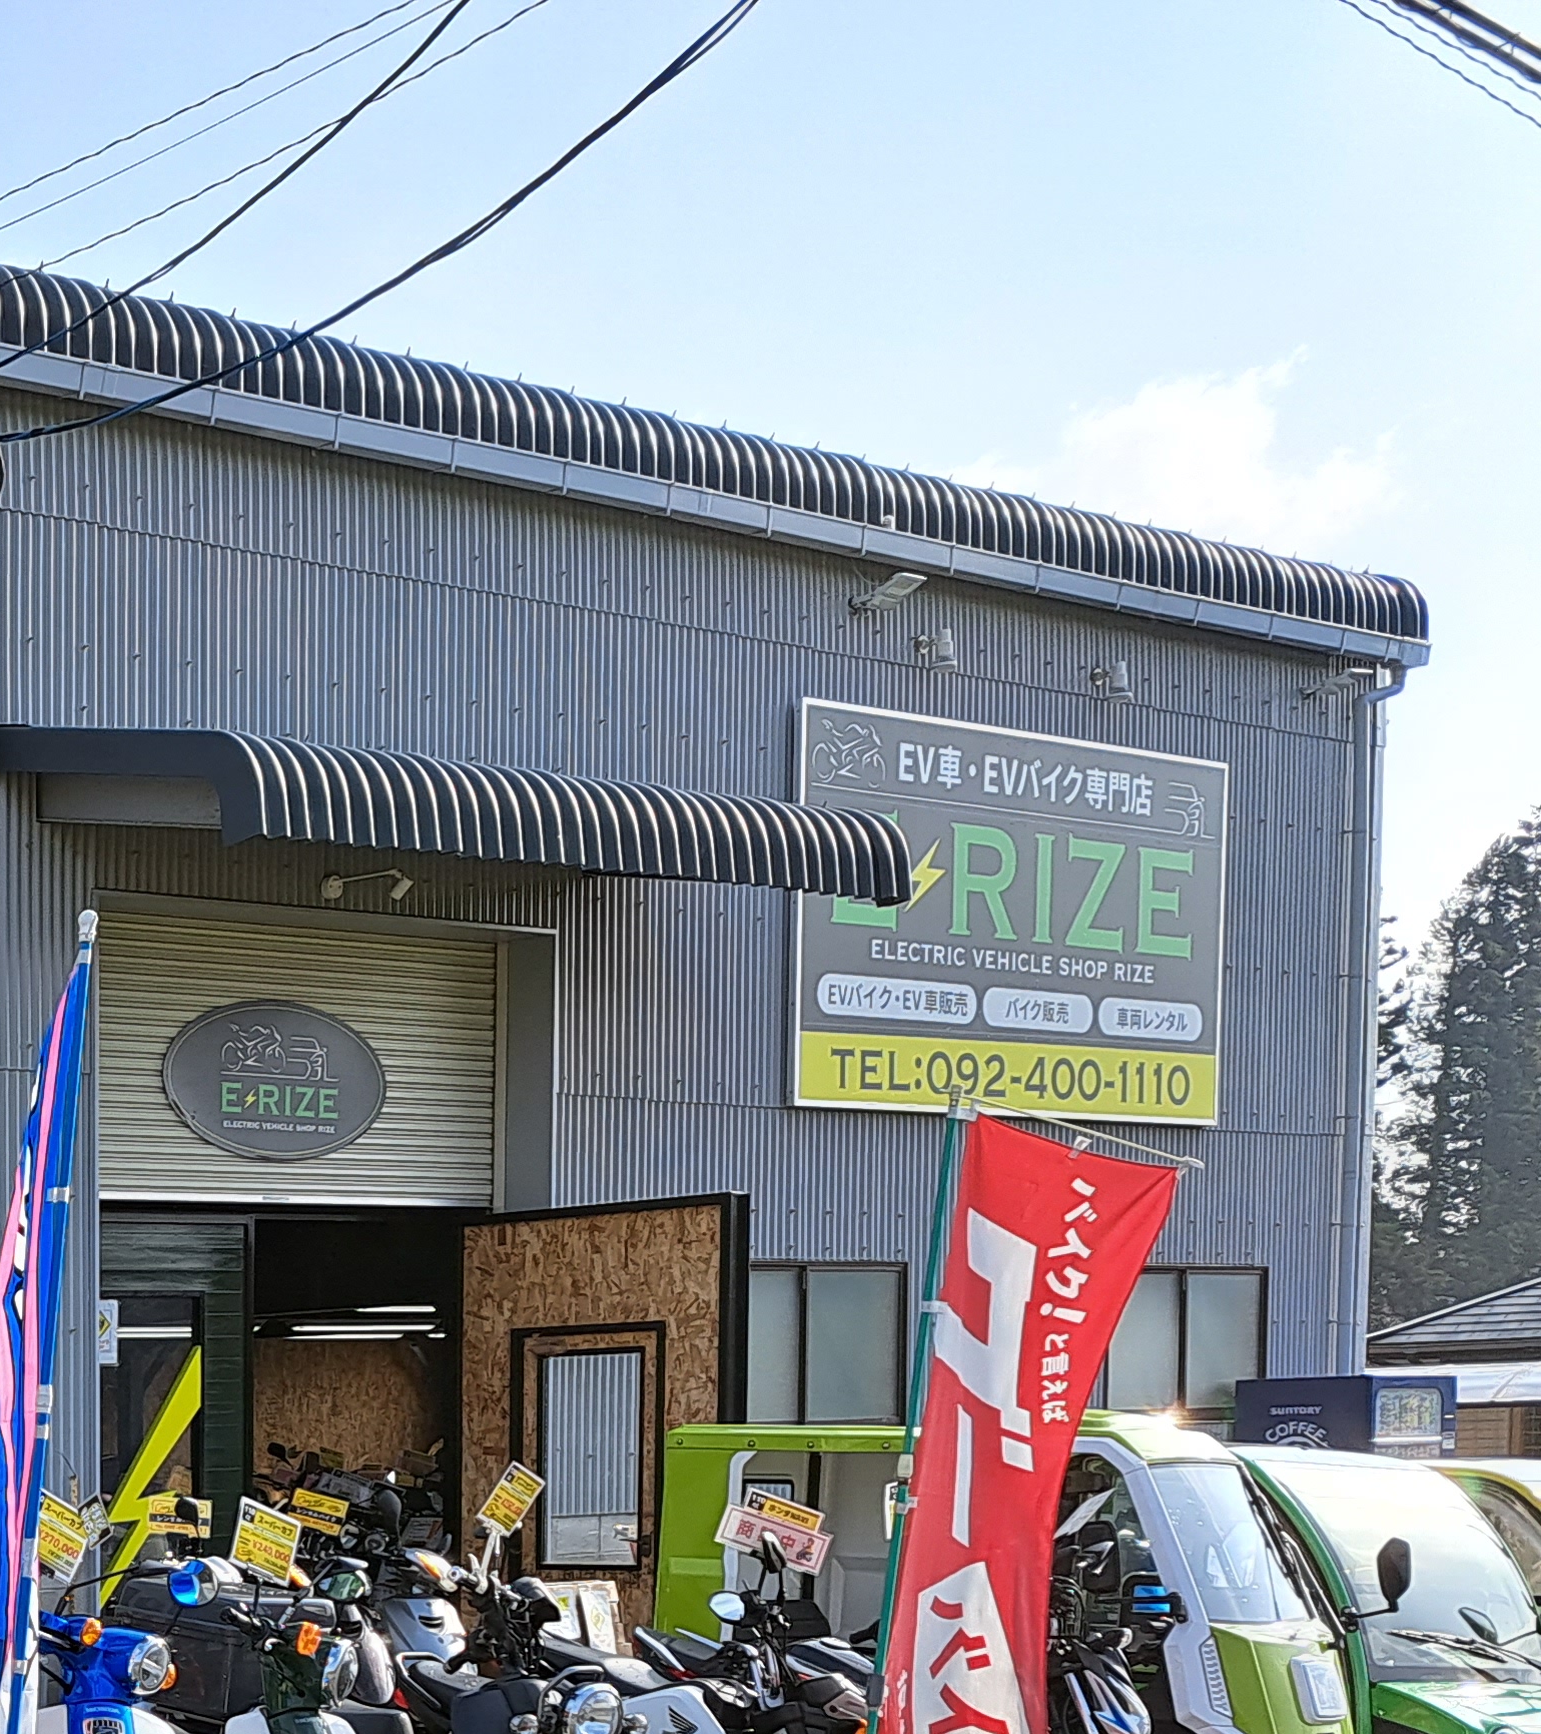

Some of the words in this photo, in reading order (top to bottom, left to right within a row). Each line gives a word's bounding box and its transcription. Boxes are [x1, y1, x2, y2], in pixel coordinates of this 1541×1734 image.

[898, 744, 1153, 817] EV車・EVバイク専門店
[871, 940, 966, 967] ELECTRIC
[972, 948, 1053, 975] VEHICLE
[1059, 958, 1108, 980] SHOP
[1114, 963, 1155, 984] RIZE
[827, 984, 969, 1018] EVバイク・EV車販売
[1005, 1000, 1069, 1025] バイク販売
[1116, 1008, 1188, 1033] 車両レンタル
[1265, 1421, 1327, 1443] COFFEE
[44, 1502, 85, 1531] スーパーカブ
[257, 1517, 294, 1537] スーパーカブ
